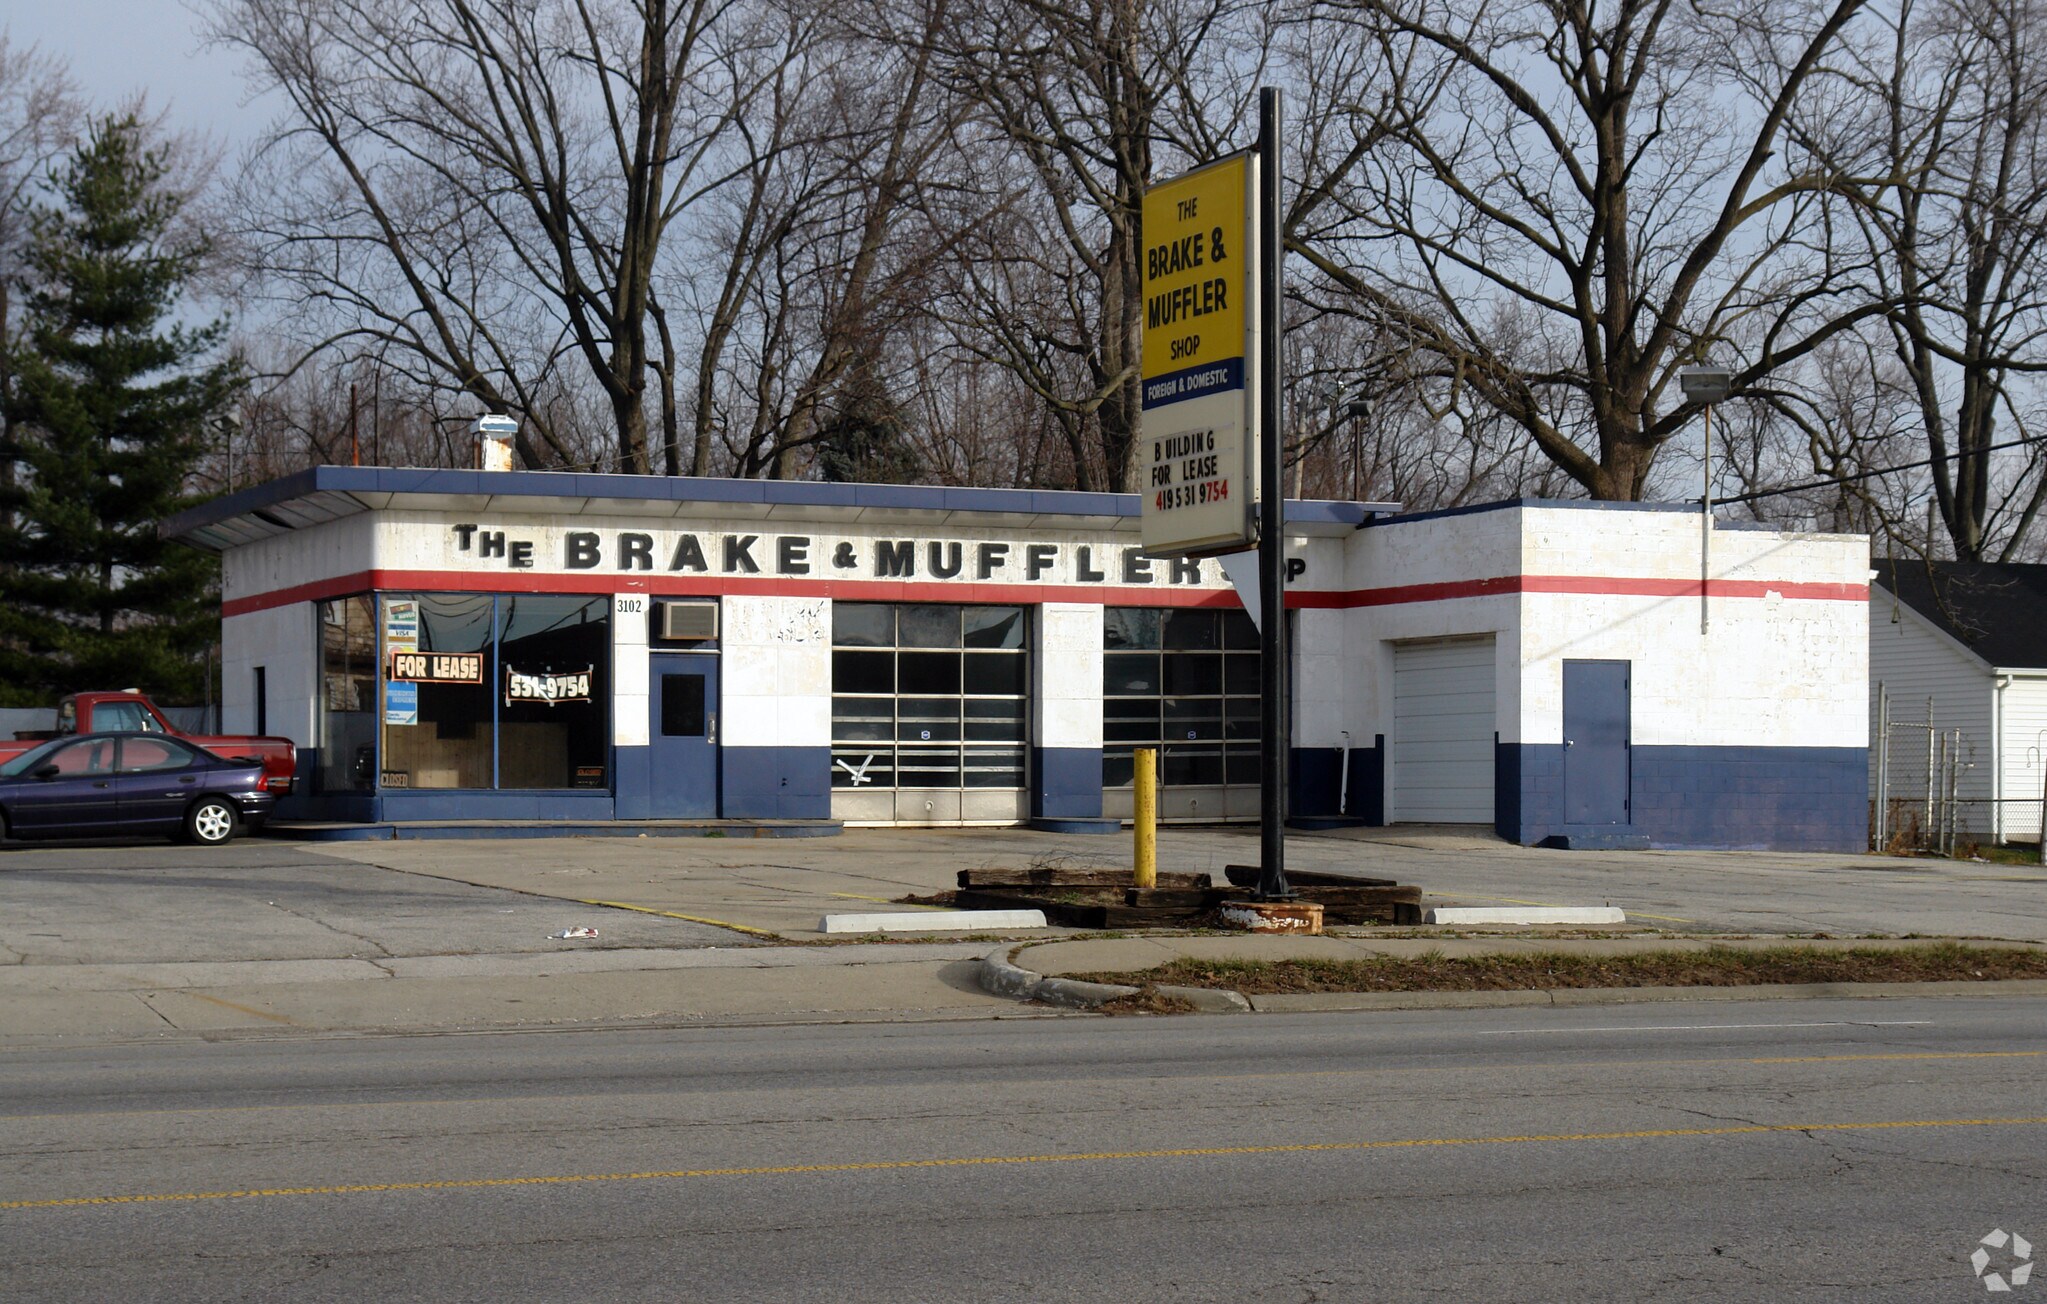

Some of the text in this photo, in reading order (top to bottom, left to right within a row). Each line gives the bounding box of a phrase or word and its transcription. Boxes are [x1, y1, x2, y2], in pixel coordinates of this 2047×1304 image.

[1177, 197, 1197, 221] THE
[1148, 226, 1227, 280] BRAKE &
[1148, 277, 1228, 330] MUFFLER
[1171, 334, 1200, 360] SHOP
[1148, 368, 1228, 401] FOREIGN & DOMESTIC
[1152, 455, 1217, 488] FOR LEASE
[452, 524, 534, 568] THE
[564, 531, 811, 574] BRAKE
[831, 541, 858, 569] &
[873, 539, 1201, 585] MUFFLER
[617, 599, 642, 614] 3102
[396, 655, 479, 679] FOR LEASE
[510, 674, 589, 699] 531-9754
[381, 772, 408, 788] CLOSED
